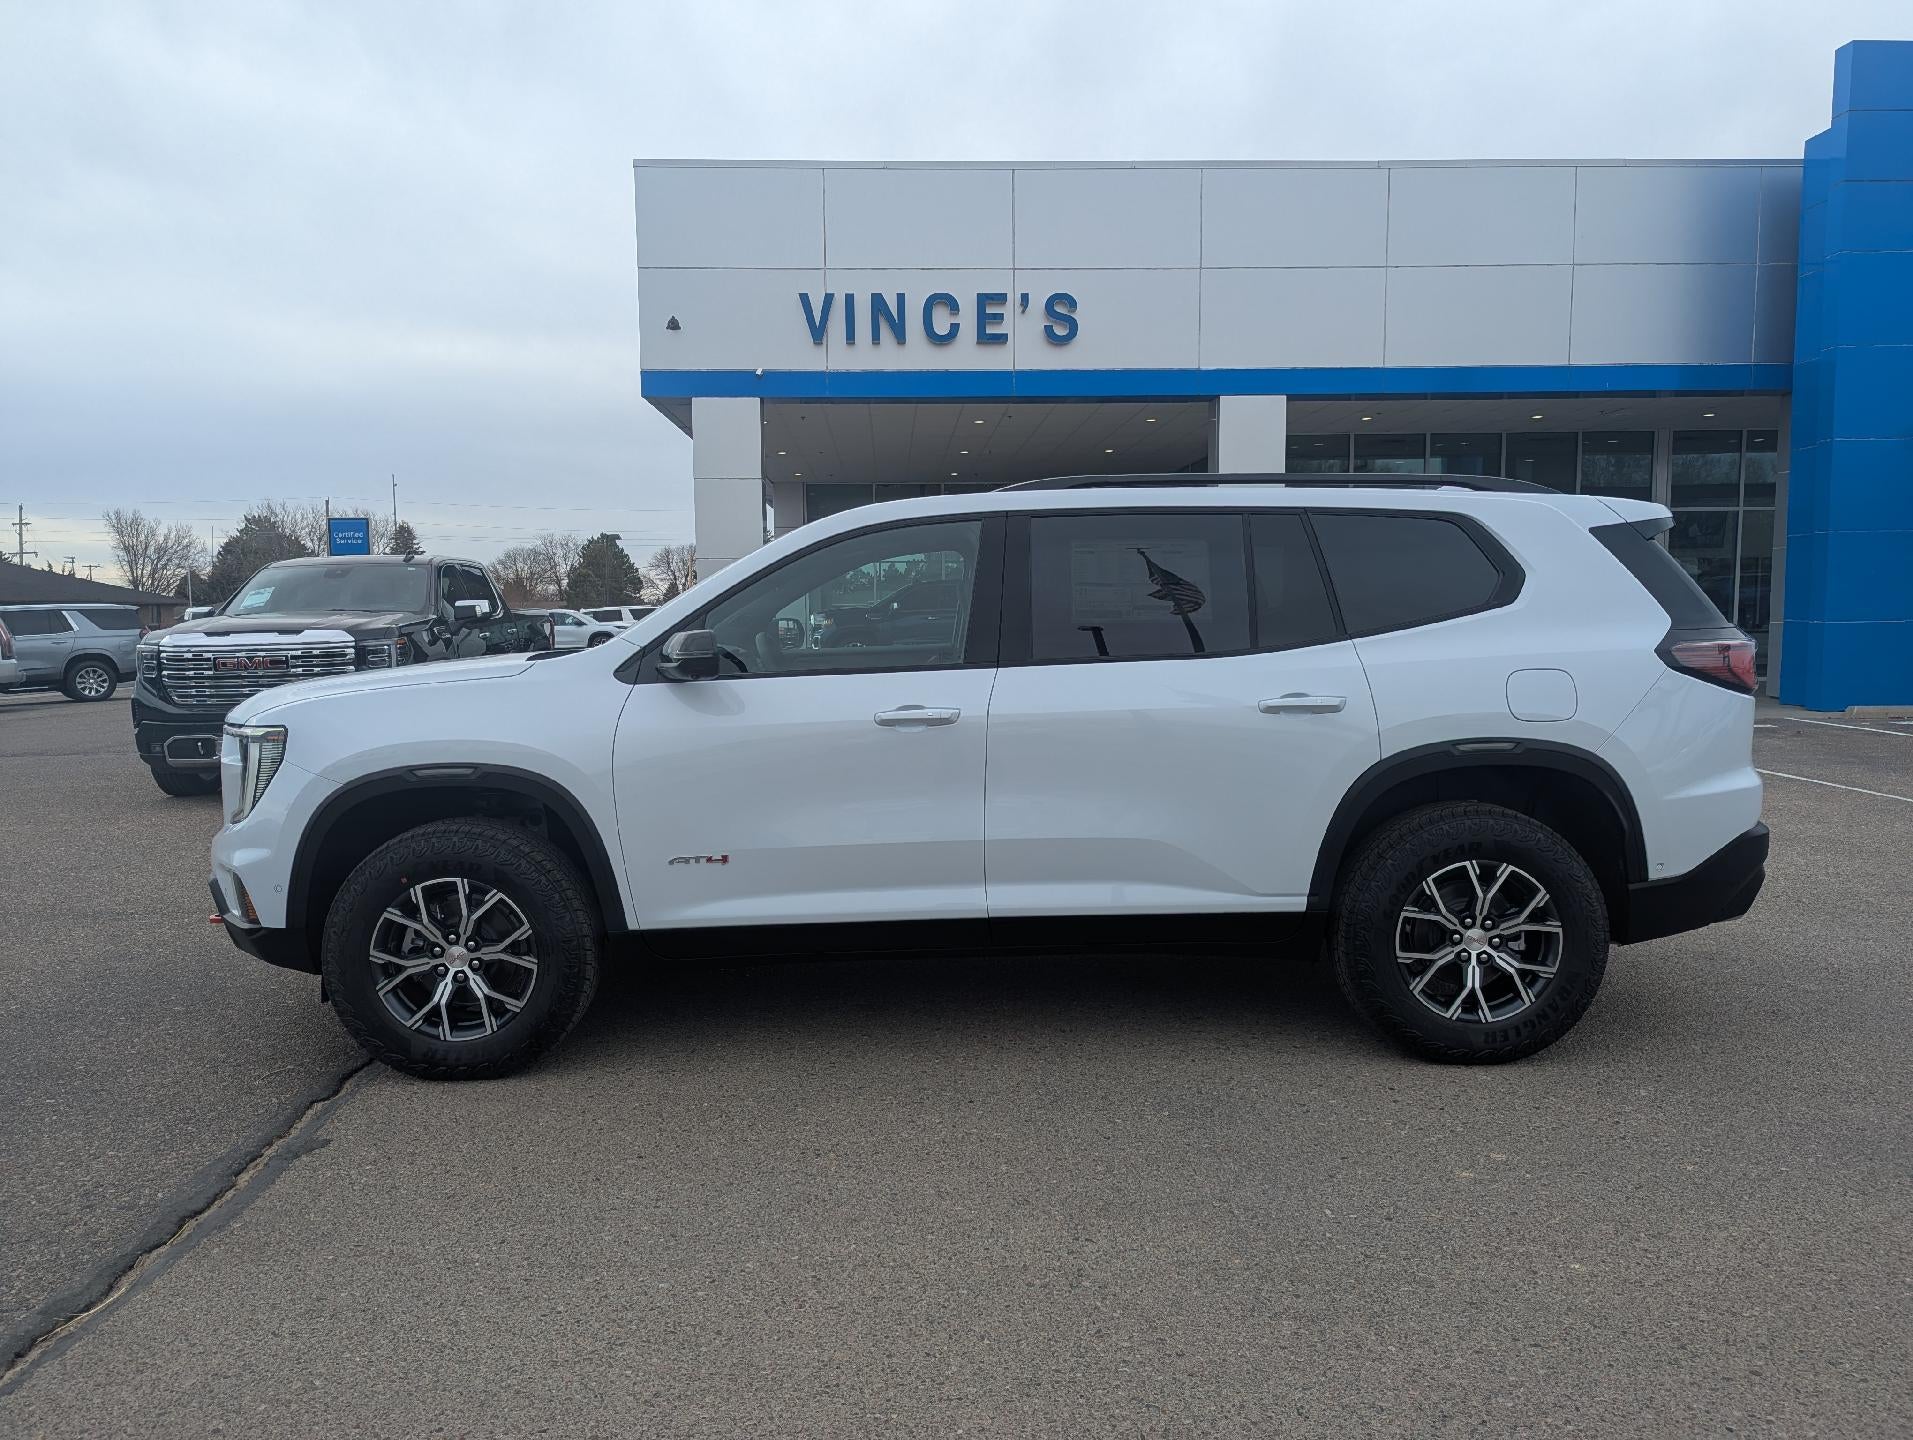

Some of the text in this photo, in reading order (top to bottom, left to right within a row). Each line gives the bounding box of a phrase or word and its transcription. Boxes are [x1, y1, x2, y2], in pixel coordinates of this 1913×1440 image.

[798, 292, 1079, 345] VINCE'S
[216, 657, 287, 670] GMC
[668, 854, 729, 865] AT4
